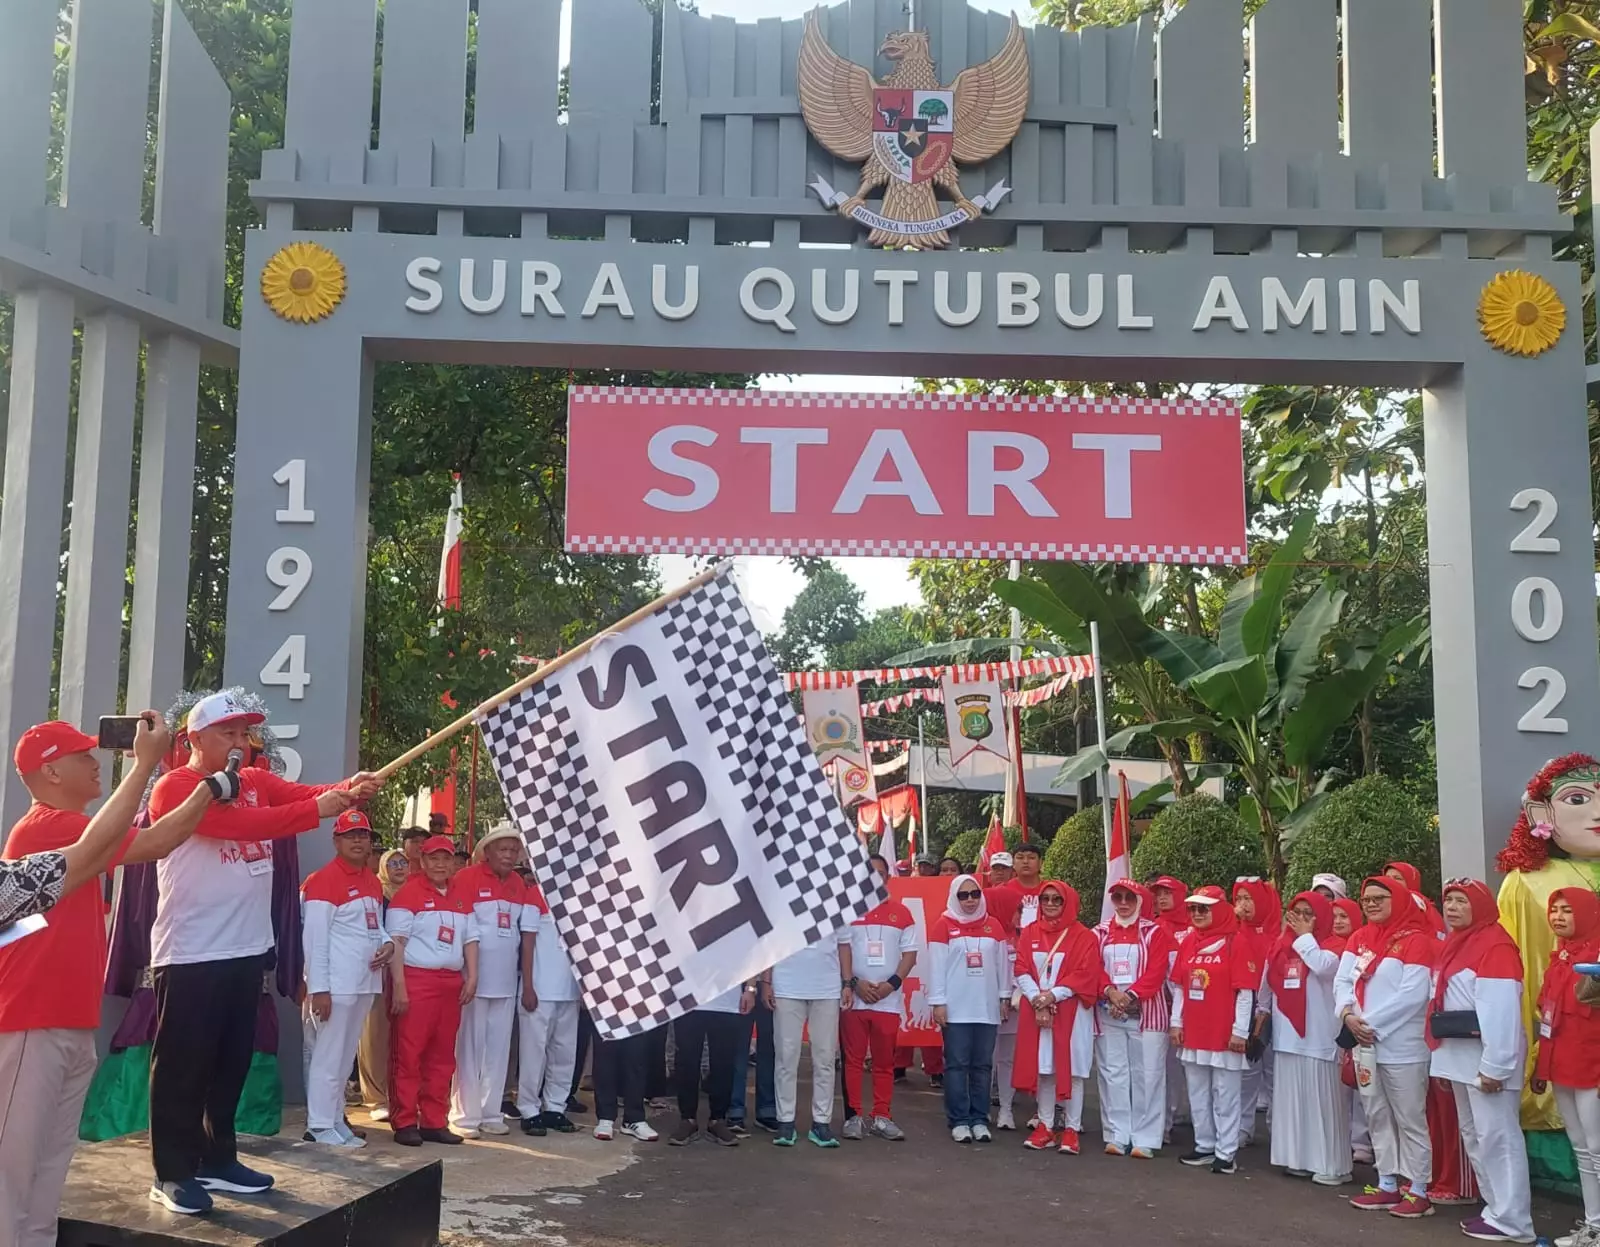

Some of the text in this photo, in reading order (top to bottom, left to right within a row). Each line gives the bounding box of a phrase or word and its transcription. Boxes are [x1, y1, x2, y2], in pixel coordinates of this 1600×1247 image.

[853, 207, 967, 233] BHINNEKA TUNGGAL IKA
[405, 256, 1421, 336] SURAU QUTUBUL AMIN
[642, 424, 1162, 519] START
[576, 644, 774, 952] START
